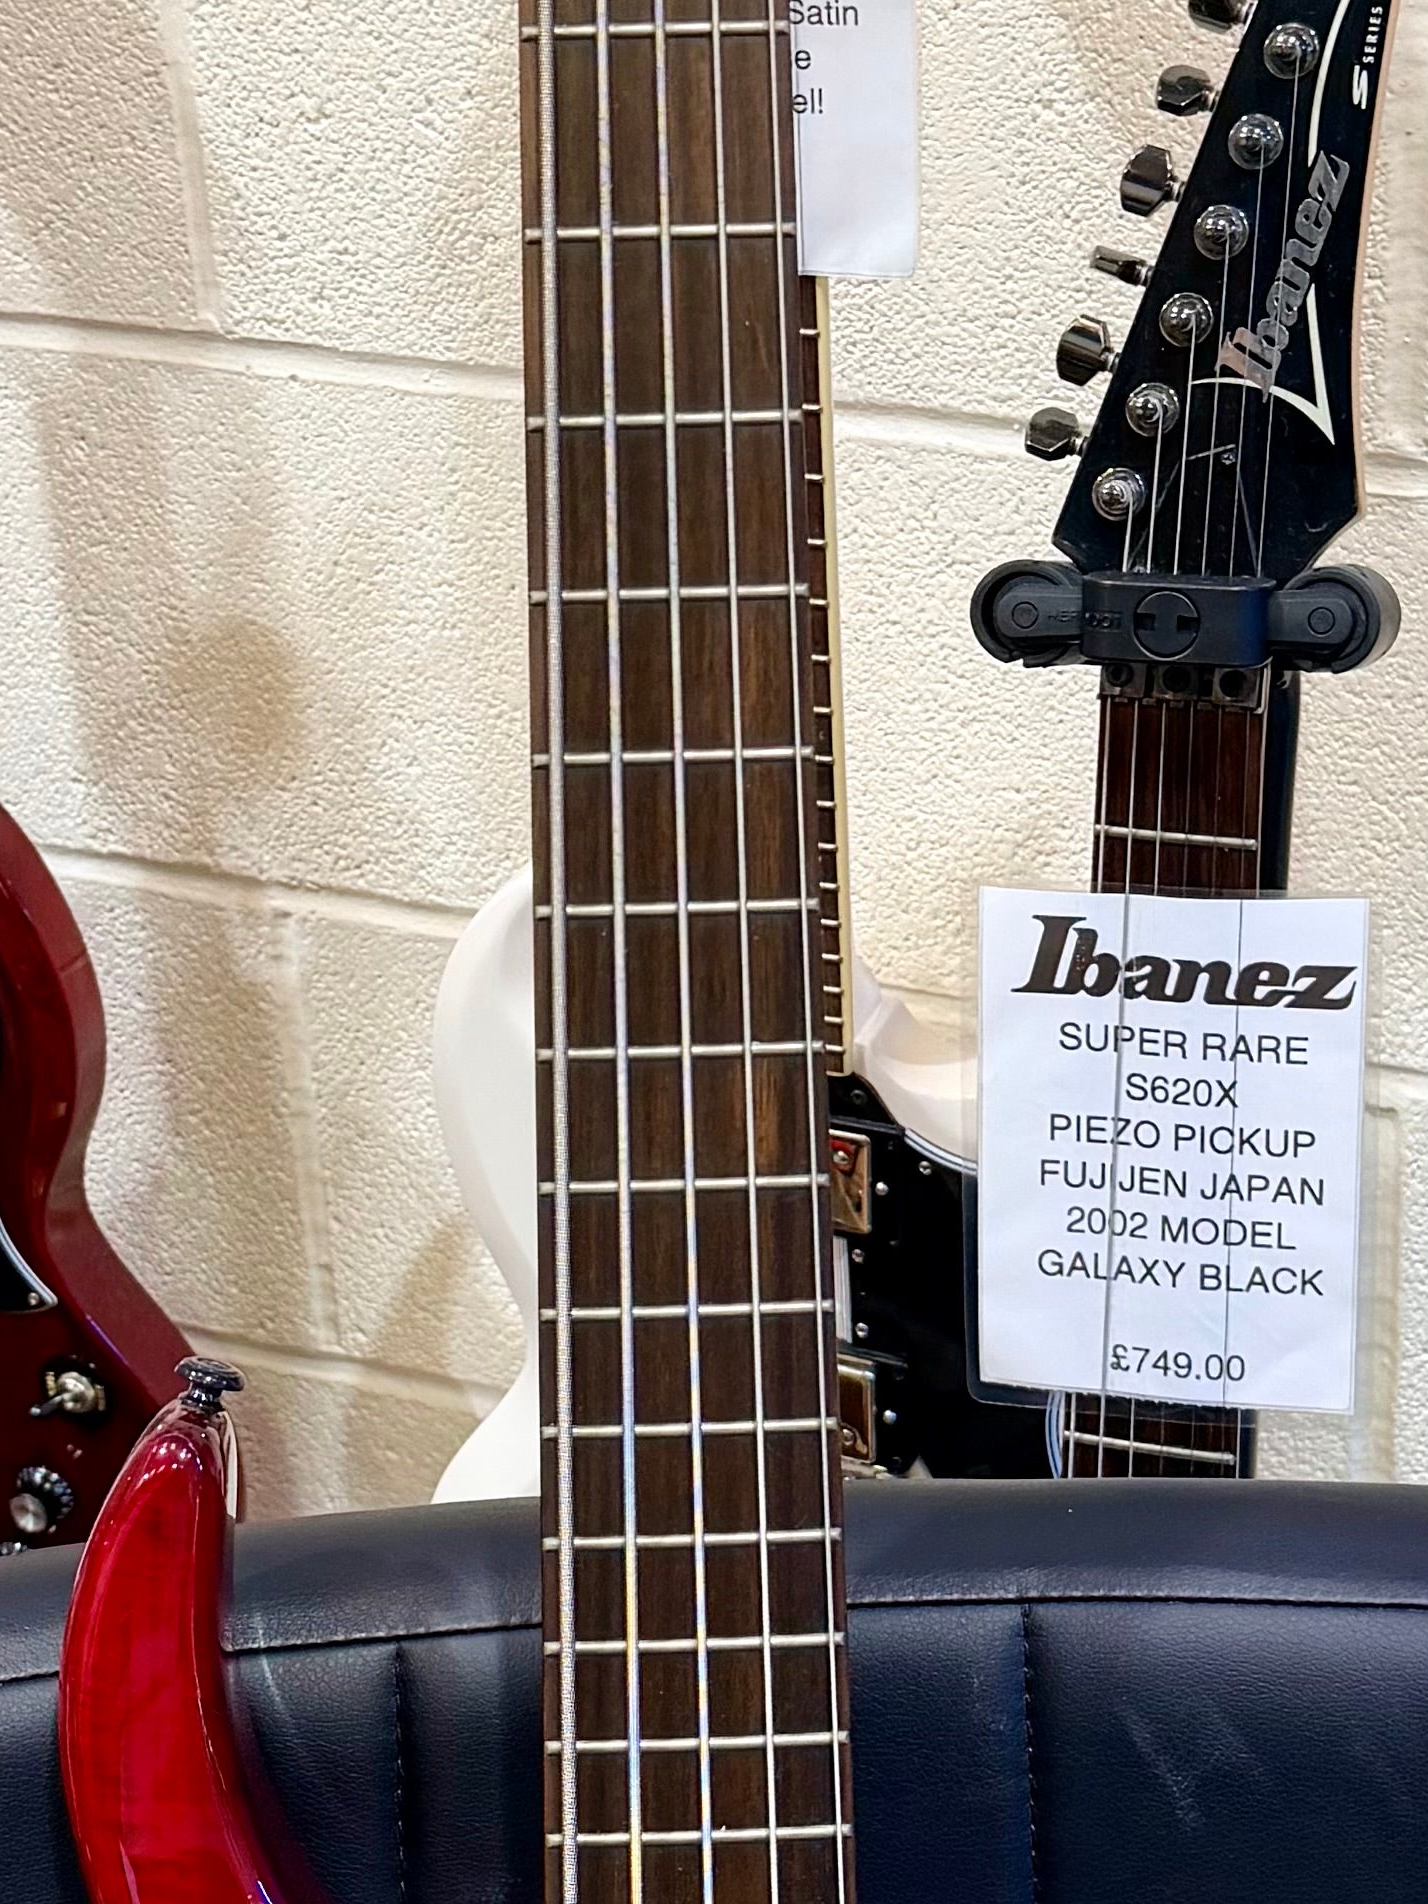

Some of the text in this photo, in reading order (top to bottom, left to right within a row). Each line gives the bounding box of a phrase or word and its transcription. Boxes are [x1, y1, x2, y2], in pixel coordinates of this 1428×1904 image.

[1352, 6, 1384, 110] S SERIES
[1215, 150, 1351, 404] Ibanez
[1011, 913, 1358, 1011] Ibanez
[1059, 1021, 1309, 1065] SUPER RARE
[1125, 1072, 1239, 1108] S620X
[1049, 1113, 1316, 1158] PIEZO PICKUP
[1200, 1172, 1324, 1206] JAPAN
[1066, 1205, 1297, 1250] 2002 MODEL
[1037, 1249, 1324, 1297] GALAXY BLACK
[1110, 1344, 1246, 1383] £749.00
